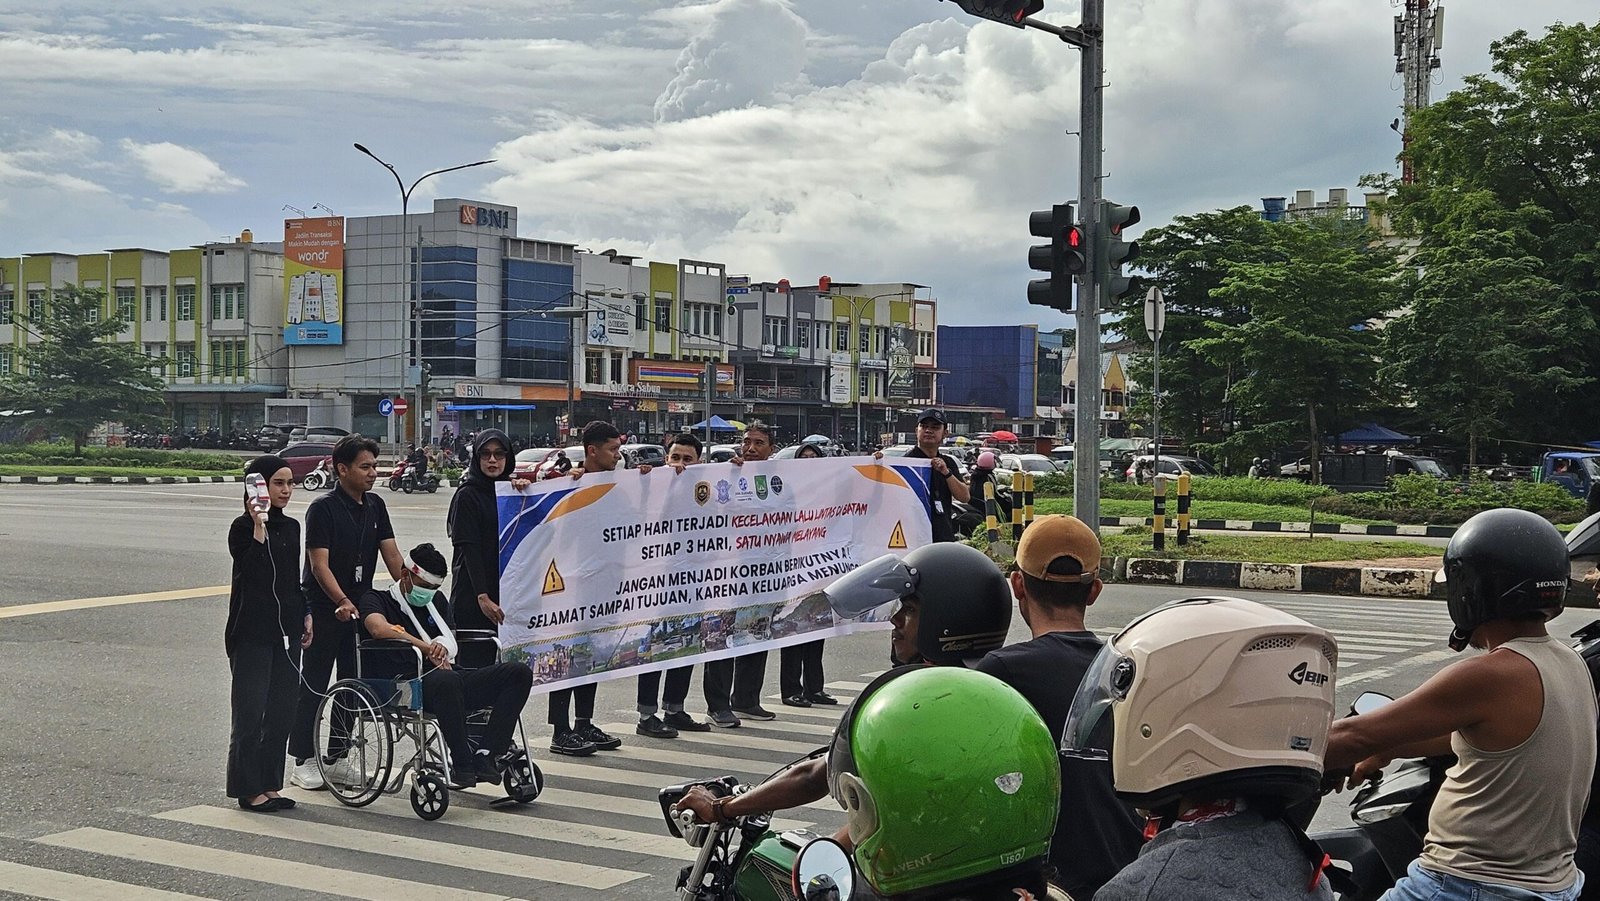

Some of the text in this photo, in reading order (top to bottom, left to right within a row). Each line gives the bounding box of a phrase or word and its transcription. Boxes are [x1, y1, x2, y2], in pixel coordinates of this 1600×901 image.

[478, 207, 509, 229] BNI
[298, 249, 329, 261] wondr
[467, 385, 484, 396] BNI
[602, 523, 641, 542] SETIAP
[644, 520, 673, 536] HARI
[676, 515, 728, 532] TERJADI
[732, 512, 793, 528] KECELAKAAN
[794, 510, 814, 523] LALU
[814, 506, 836, 520] LINTAS
[842, 502, 868, 516] BATAM
[641, 527, 827, 560] SETIAP 3 HARI, SATU NYAWA MELAYANG
[616, 547, 851, 595] JANGAN MENJADI KORBAN BERIKUTNYA!
[1536, 580, 1566, 588] HONDA
[527, 562, 862, 629] SELAMAT SAMPAI TUJUAN, KARENA KELUARGA MENUNG
